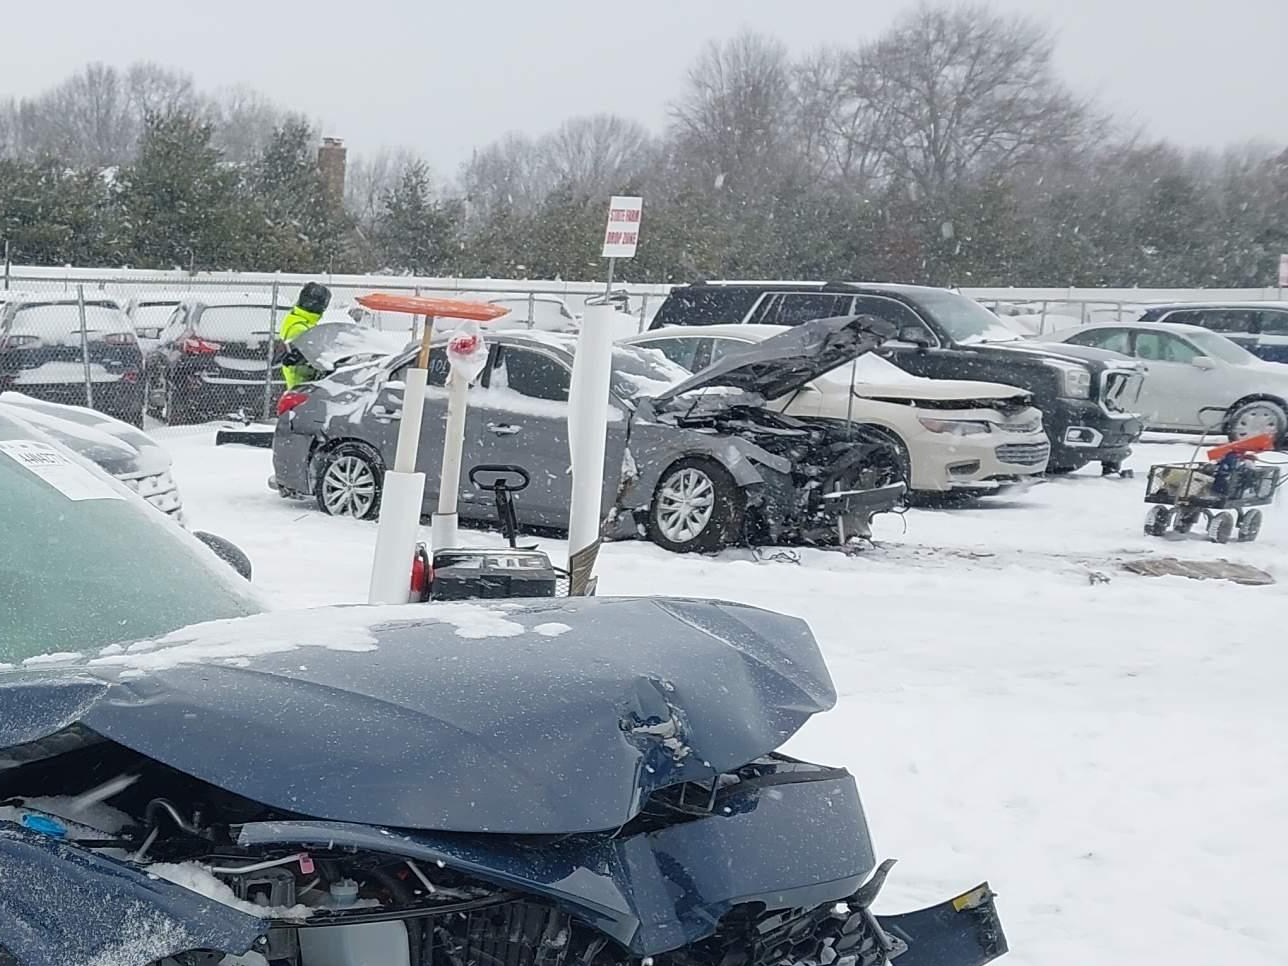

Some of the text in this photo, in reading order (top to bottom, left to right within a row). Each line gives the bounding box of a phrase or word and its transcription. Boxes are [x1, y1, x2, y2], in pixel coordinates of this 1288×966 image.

[610, 209, 625, 222] STATE
[607, 232, 637, 245] DROP ZONE
